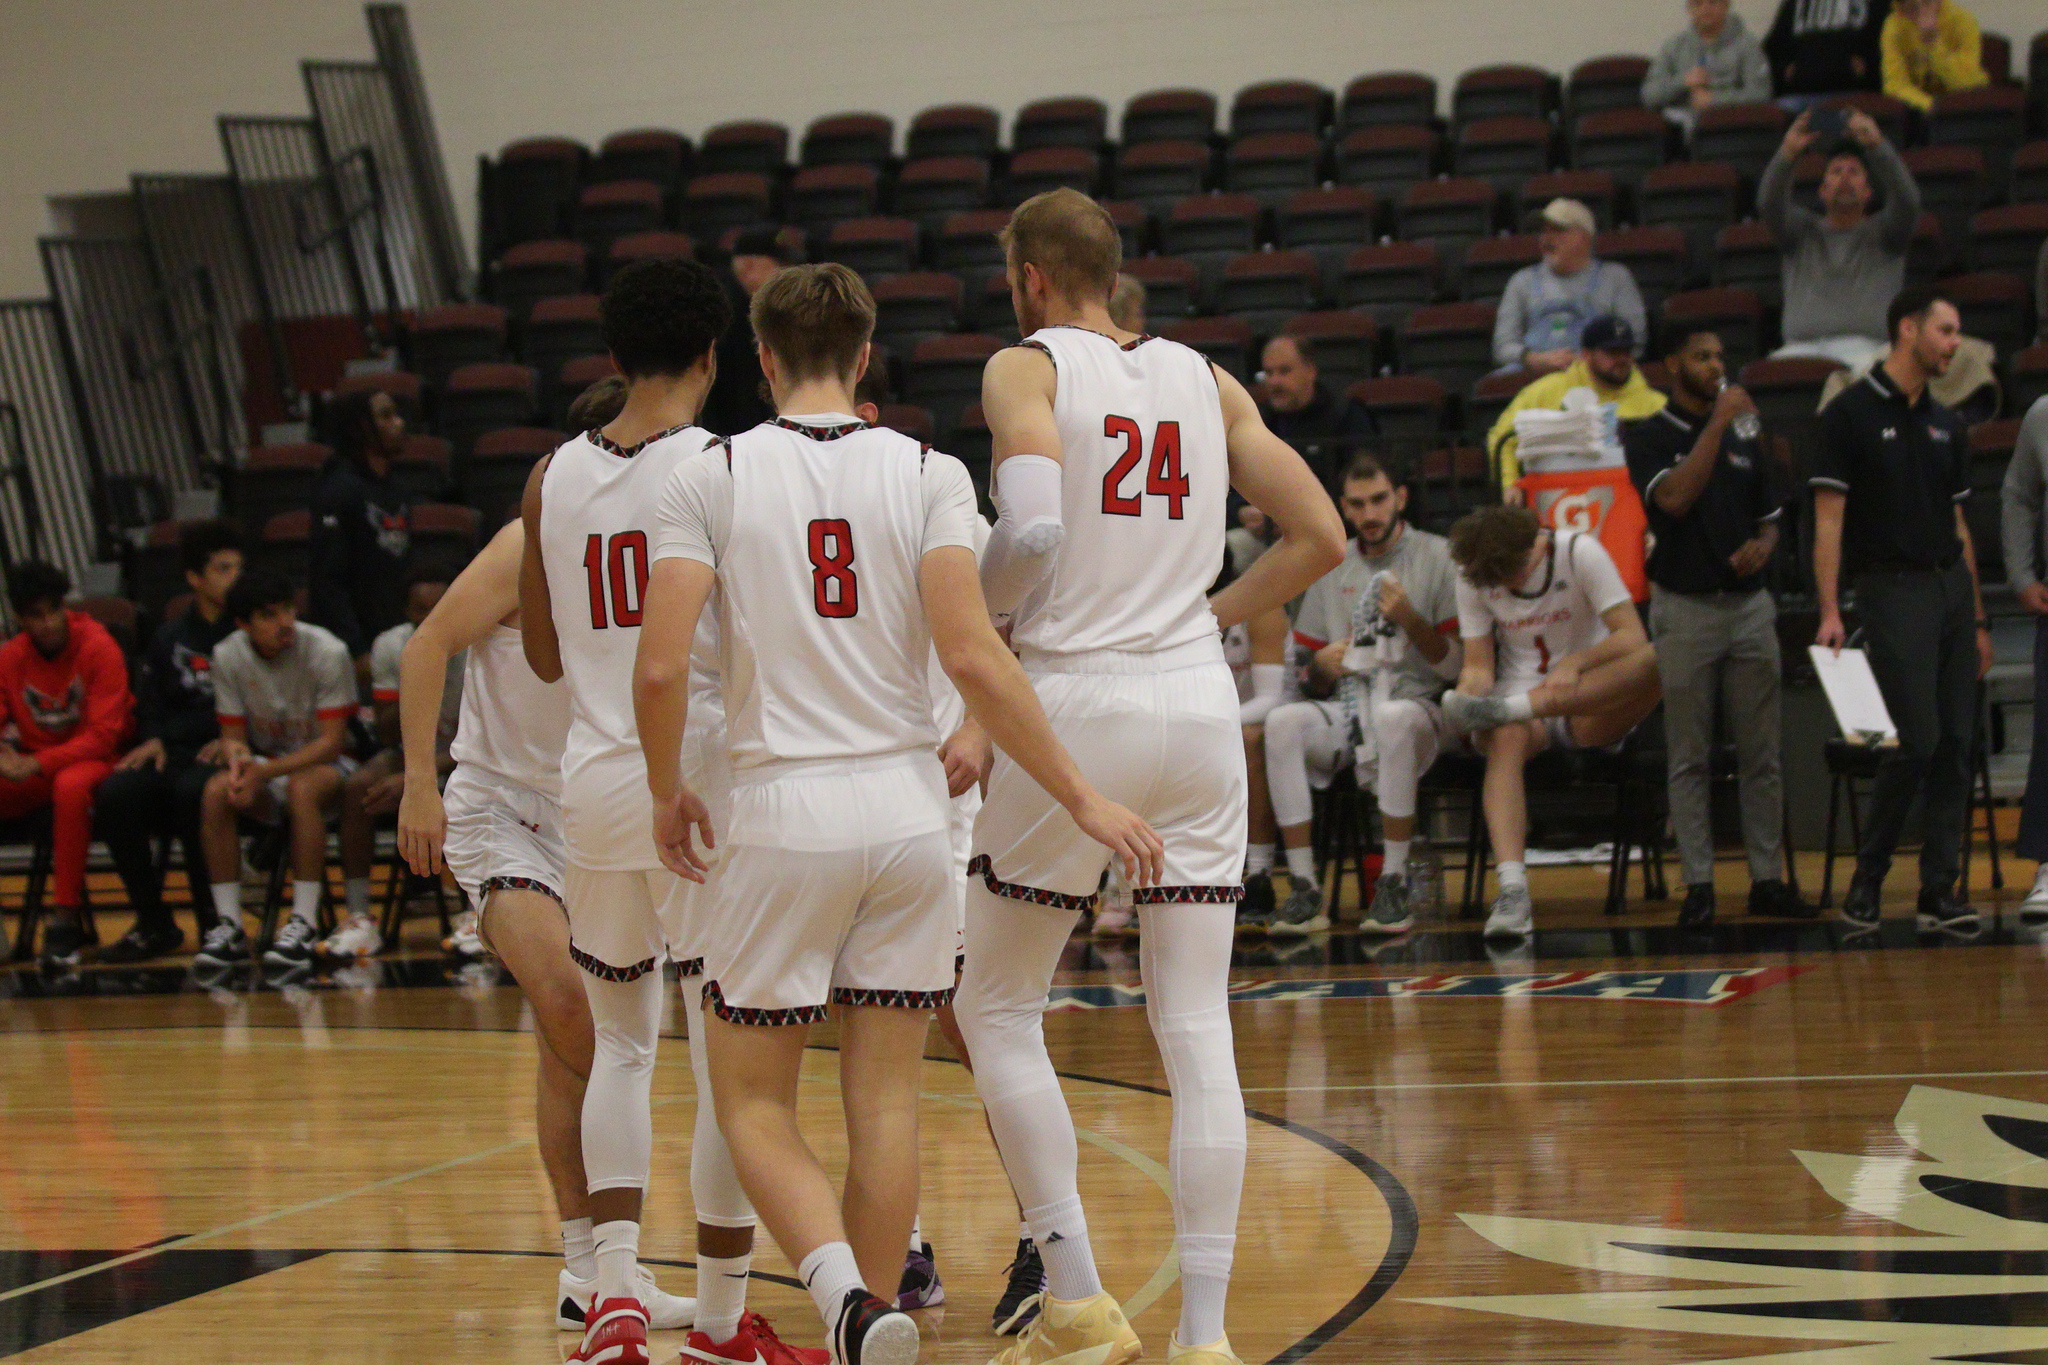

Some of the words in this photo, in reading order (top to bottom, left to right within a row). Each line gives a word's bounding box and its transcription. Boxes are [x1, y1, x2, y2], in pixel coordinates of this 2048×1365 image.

[1101, 413, 1190, 520] 24
[1554, 493, 1591, 533] G
[583, 530, 649, 630] 10
[807, 518, 858, 618] 8
[1533, 634, 1550, 674] 1
